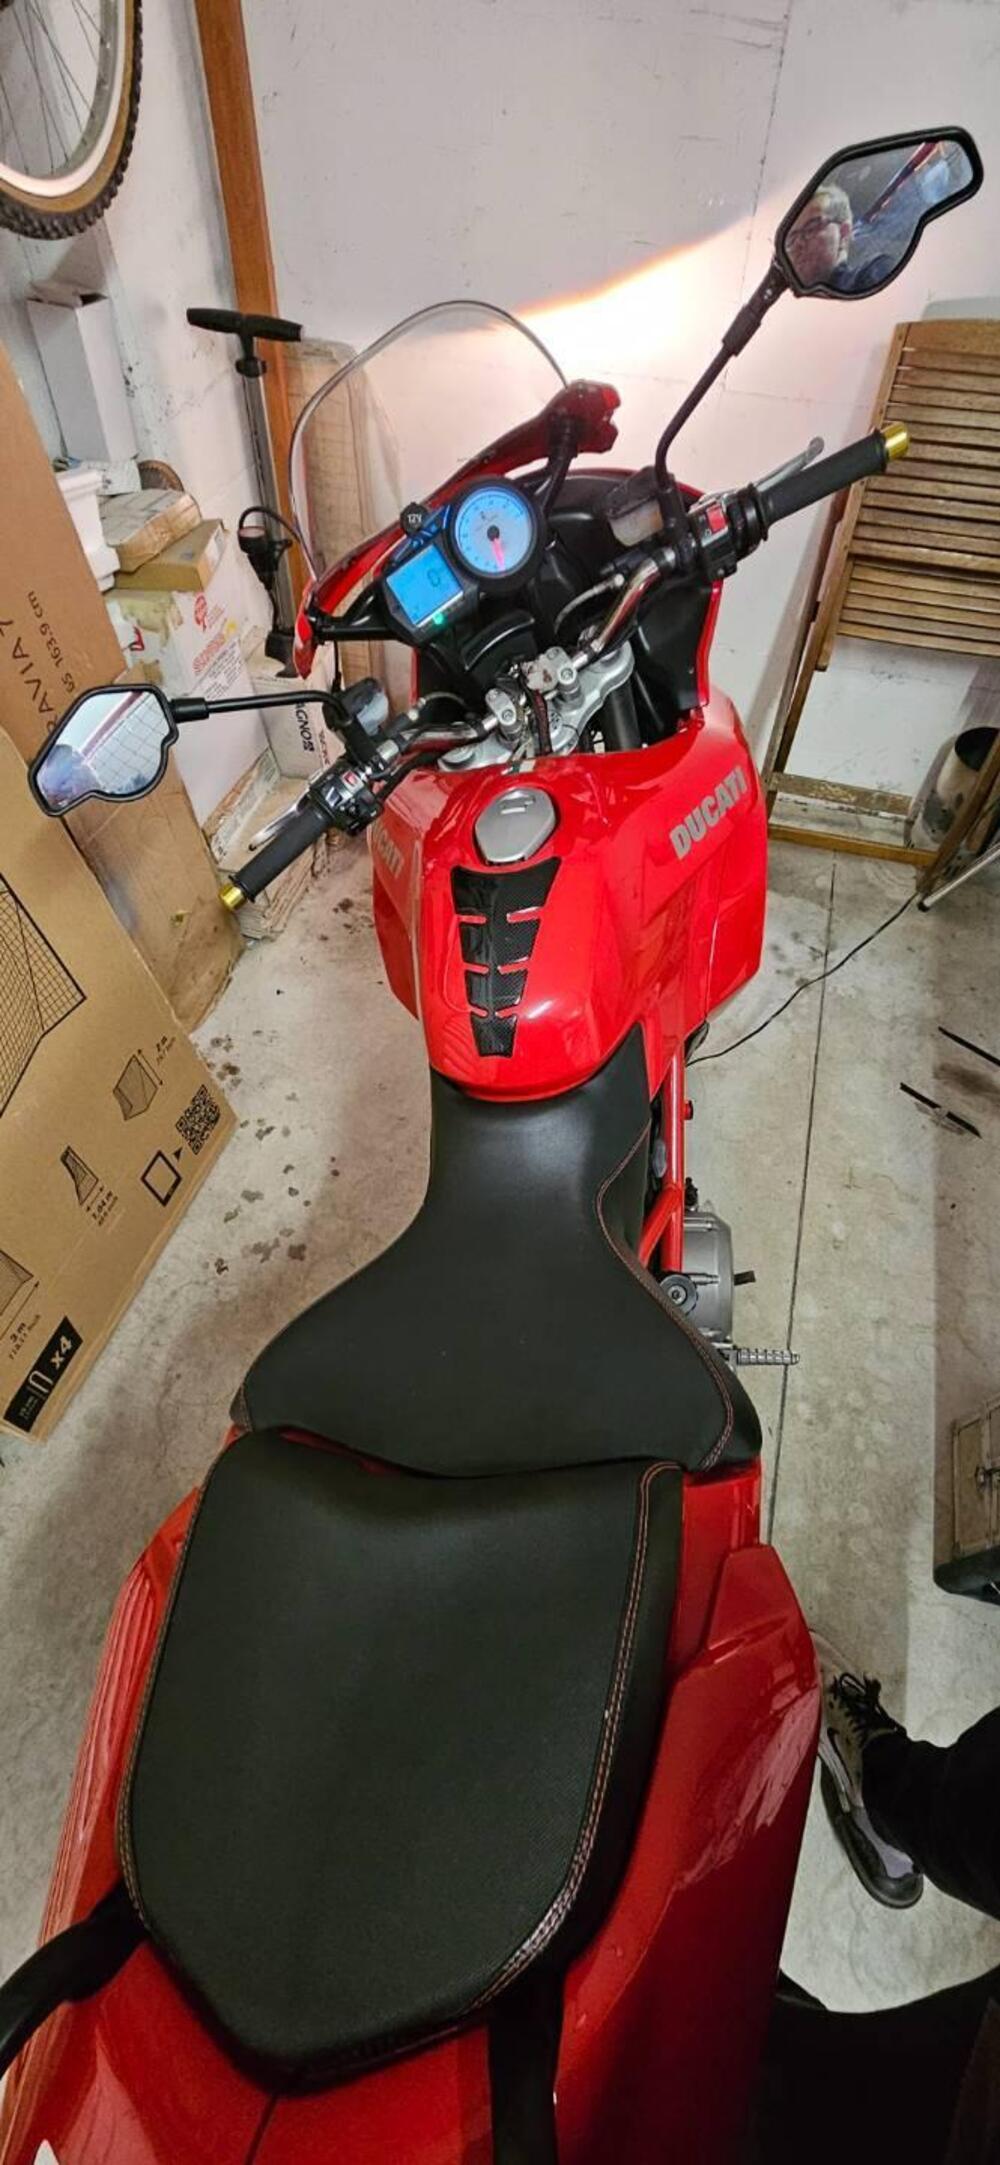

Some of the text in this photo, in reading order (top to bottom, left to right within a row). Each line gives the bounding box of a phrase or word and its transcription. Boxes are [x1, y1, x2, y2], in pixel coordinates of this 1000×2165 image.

[407, 513, 423, 525] 12V
[27, 590, 43, 619] cm
[11, 636, 60, 734] RAVIA
[669, 765, 748, 860] DUCATI
[49, 1335, 72, 1371] x4
